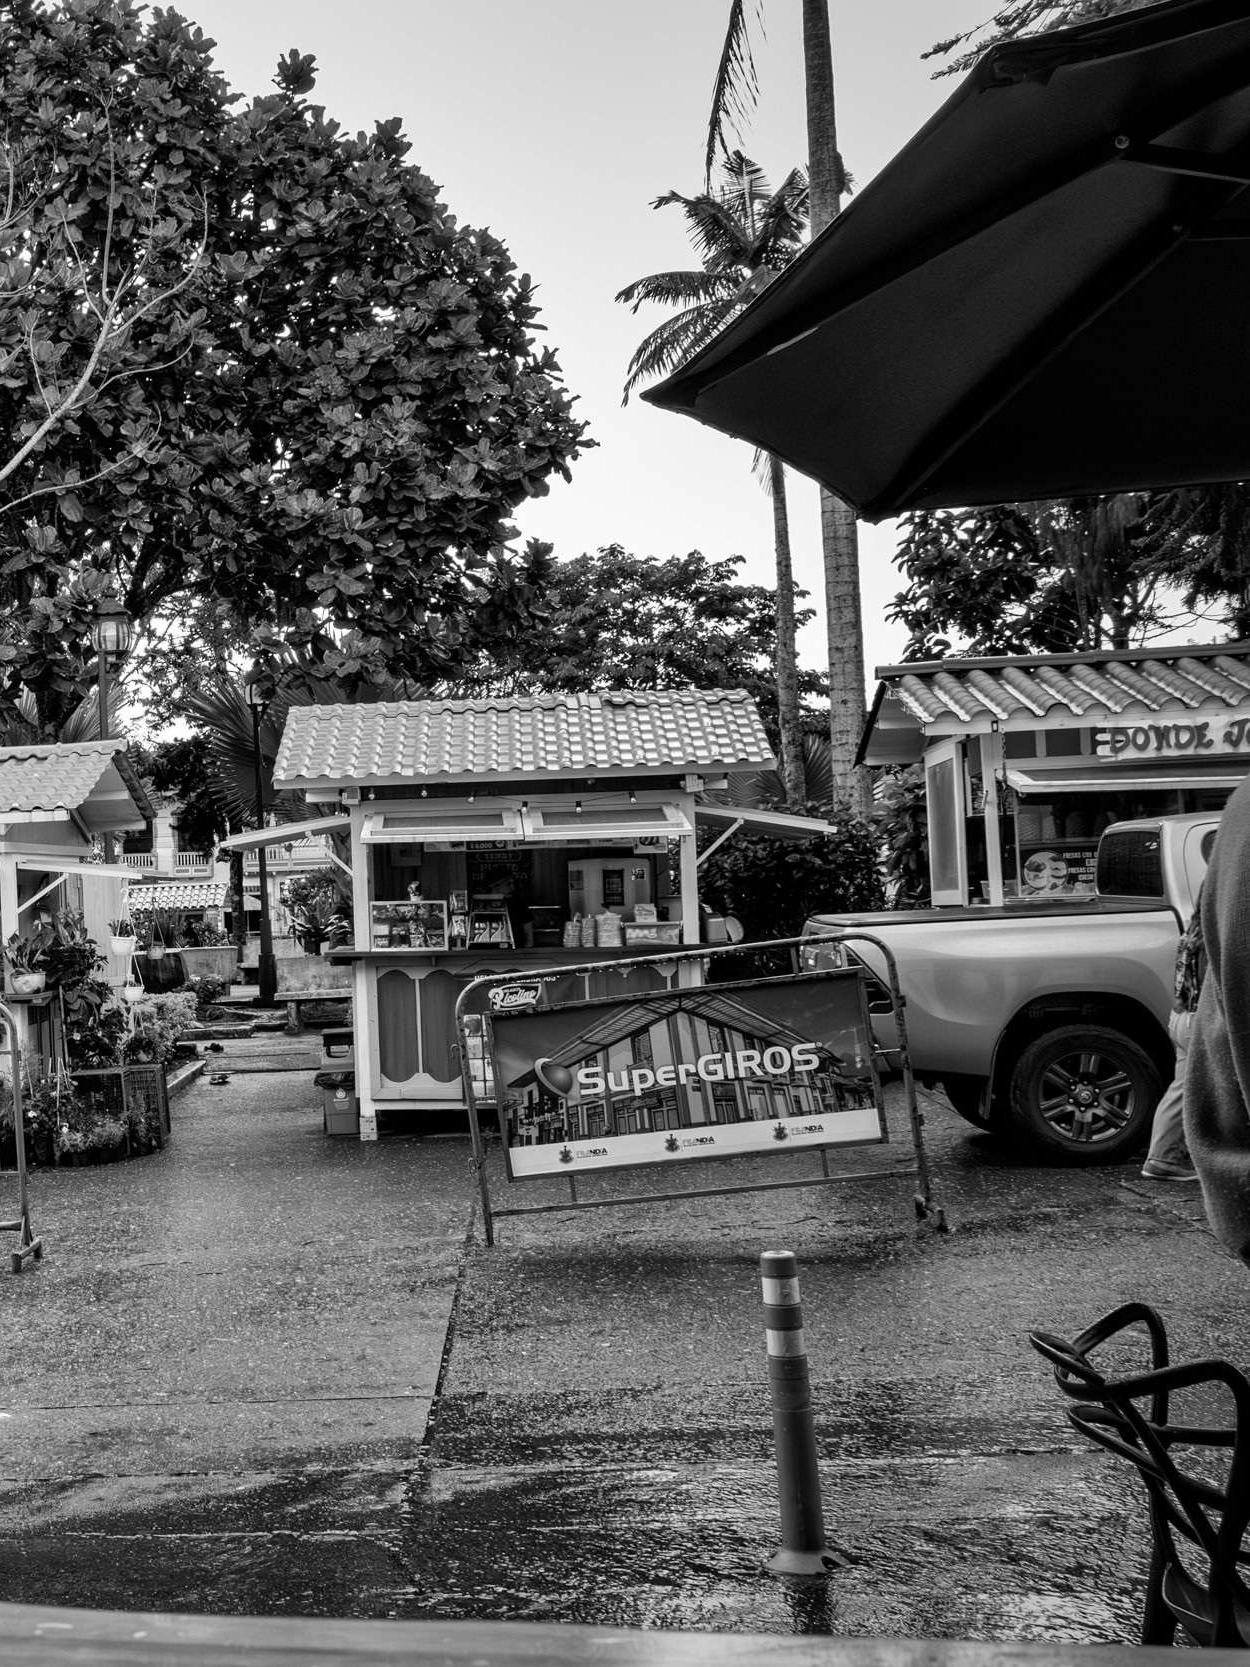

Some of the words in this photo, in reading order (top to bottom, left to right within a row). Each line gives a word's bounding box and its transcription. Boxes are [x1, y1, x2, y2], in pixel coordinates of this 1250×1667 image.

[1108, 722, 1214, 754] DONDE
[1222, 717, 1250, 748] J
[576, 1042, 820, 1096] SuperGIROS
